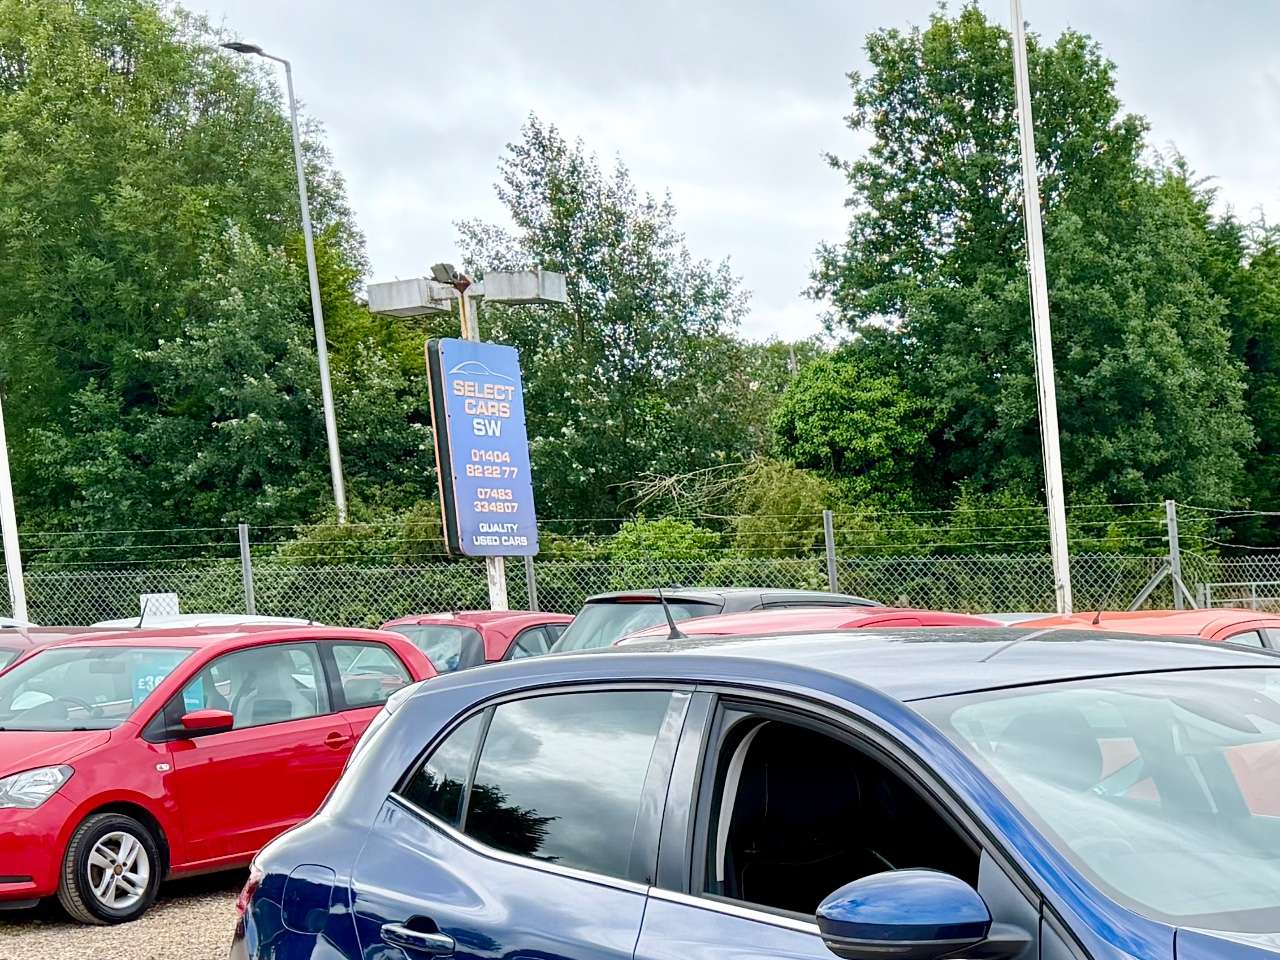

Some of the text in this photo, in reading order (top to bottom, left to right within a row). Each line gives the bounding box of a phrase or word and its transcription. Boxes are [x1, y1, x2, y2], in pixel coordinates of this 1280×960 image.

[453, 379, 515, 401] SELECT
[464, 399, 511, 418] CARS
[473, 417, 502, 437] SW
[471, 448, 511, 463] 01404
[477, 488, 513, 500] 07483
[473, 501, 519, 513] 334807
[479, 522, 518, 533] QUALITY
[473, 536, 528, 546] USED CARS
